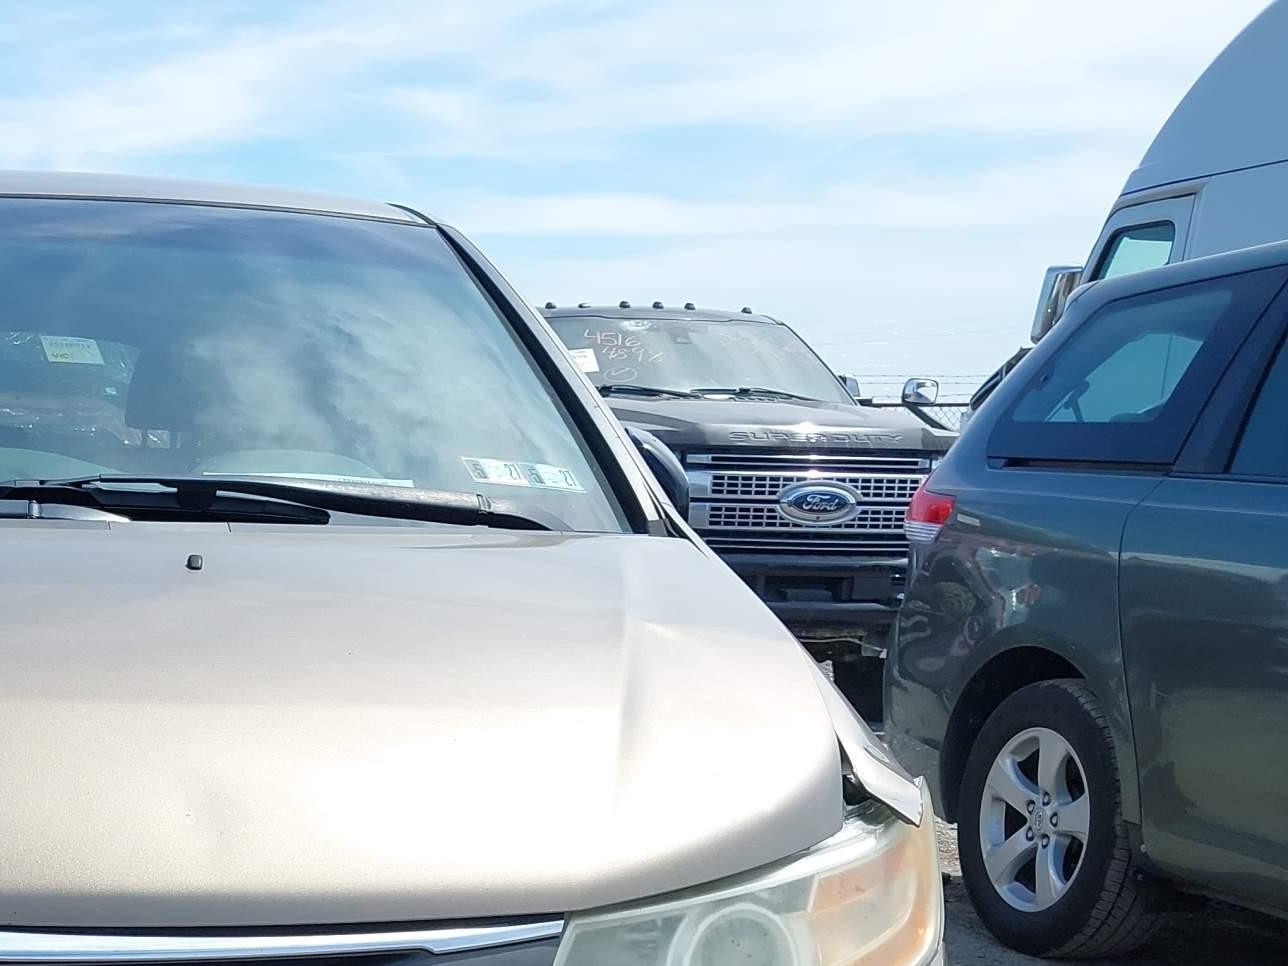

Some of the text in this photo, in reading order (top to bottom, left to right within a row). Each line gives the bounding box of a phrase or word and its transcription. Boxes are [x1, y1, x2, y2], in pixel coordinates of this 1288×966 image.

[834, 433, 903, 443] DUTY
[528, 468, 546, 484] 5
[803, 495, 839, 510] Ford
